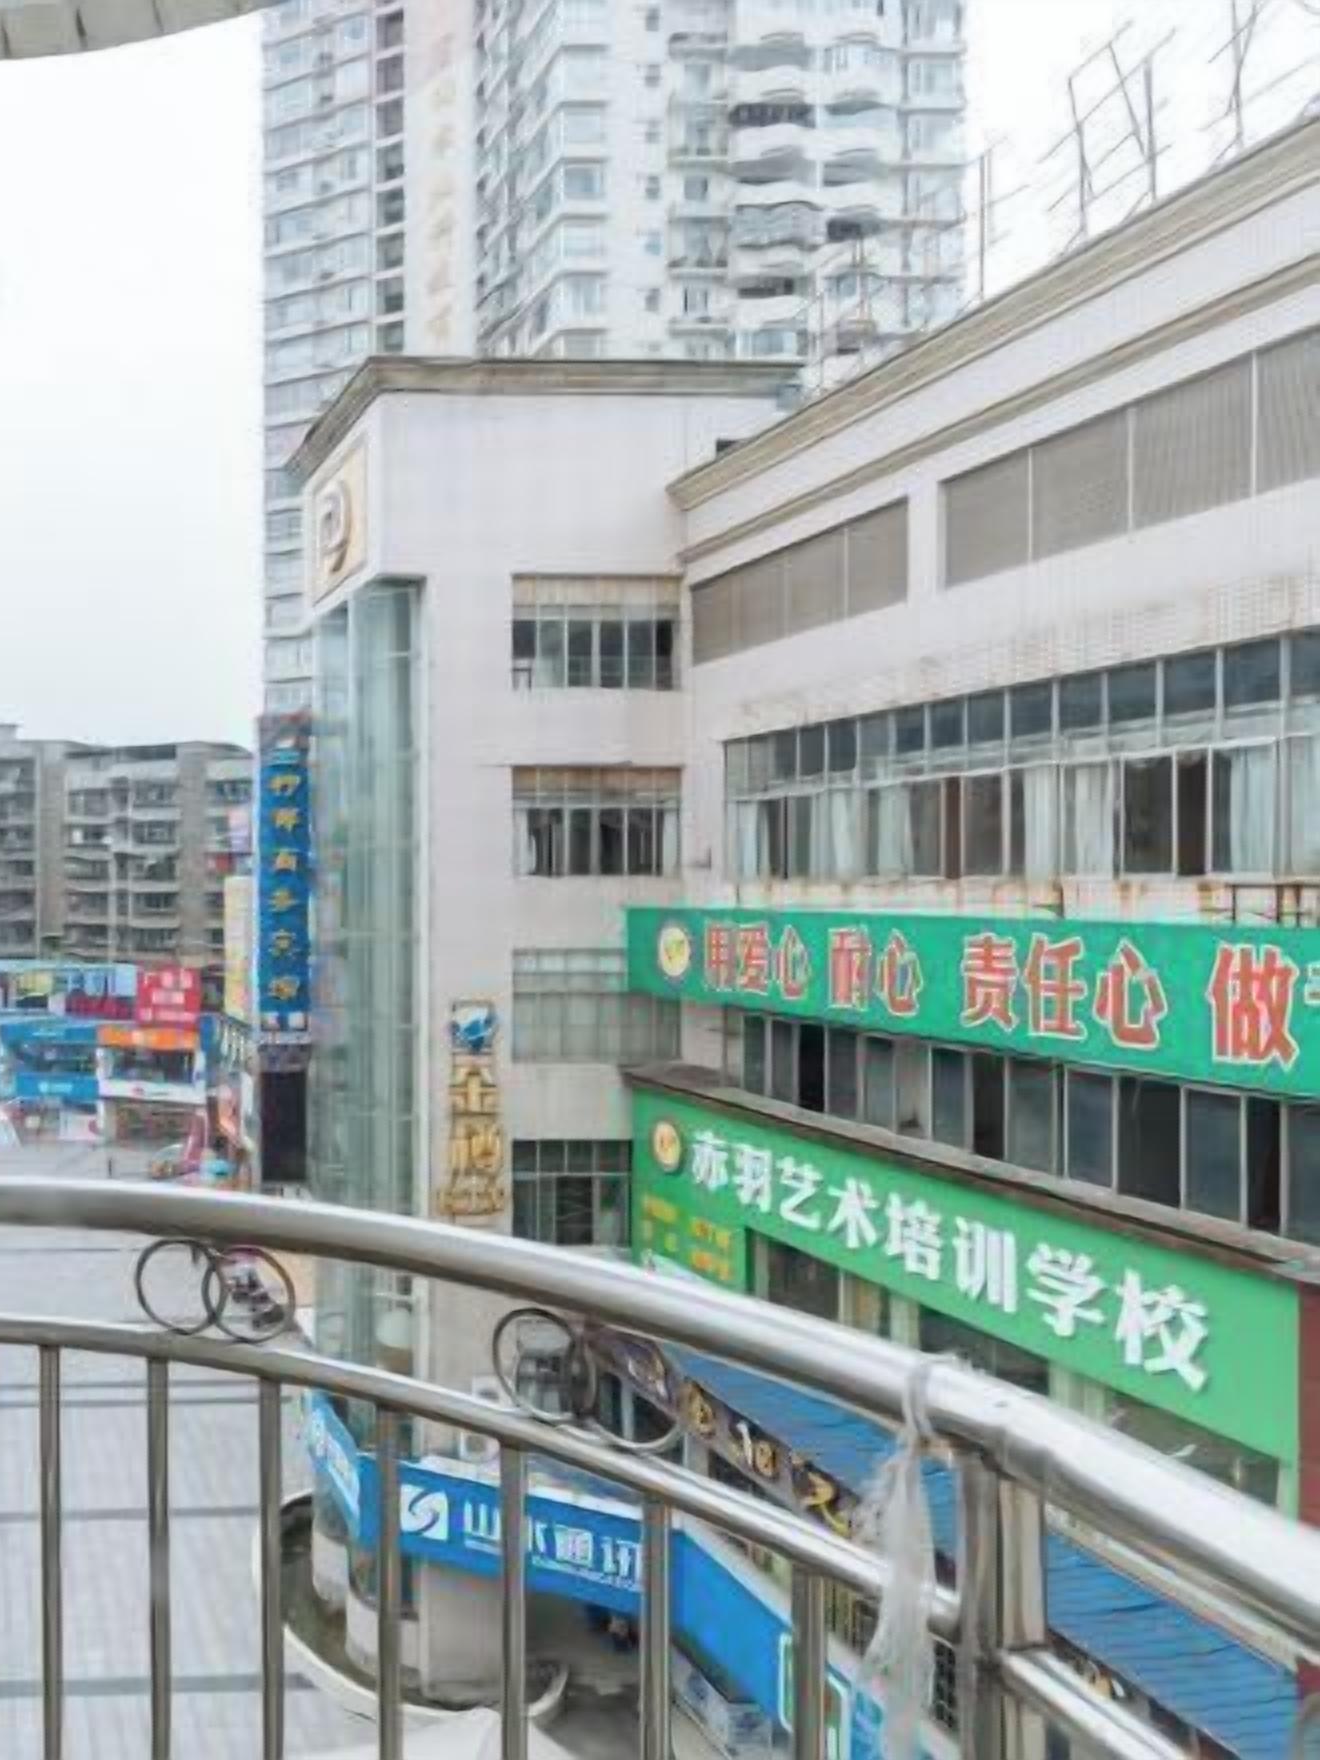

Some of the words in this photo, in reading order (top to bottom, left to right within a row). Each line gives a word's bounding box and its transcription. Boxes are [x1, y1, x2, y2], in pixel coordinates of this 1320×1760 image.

[704, 919, 812, 1000] 用爱心
[827, 924, 925, 1017] 耐心
[960, 931, 1168, 1050] 责任心
[1205, 940, 1320, 1070] 做
[691, 1130, 1210, 1393] 赤羽艺术培训学校
